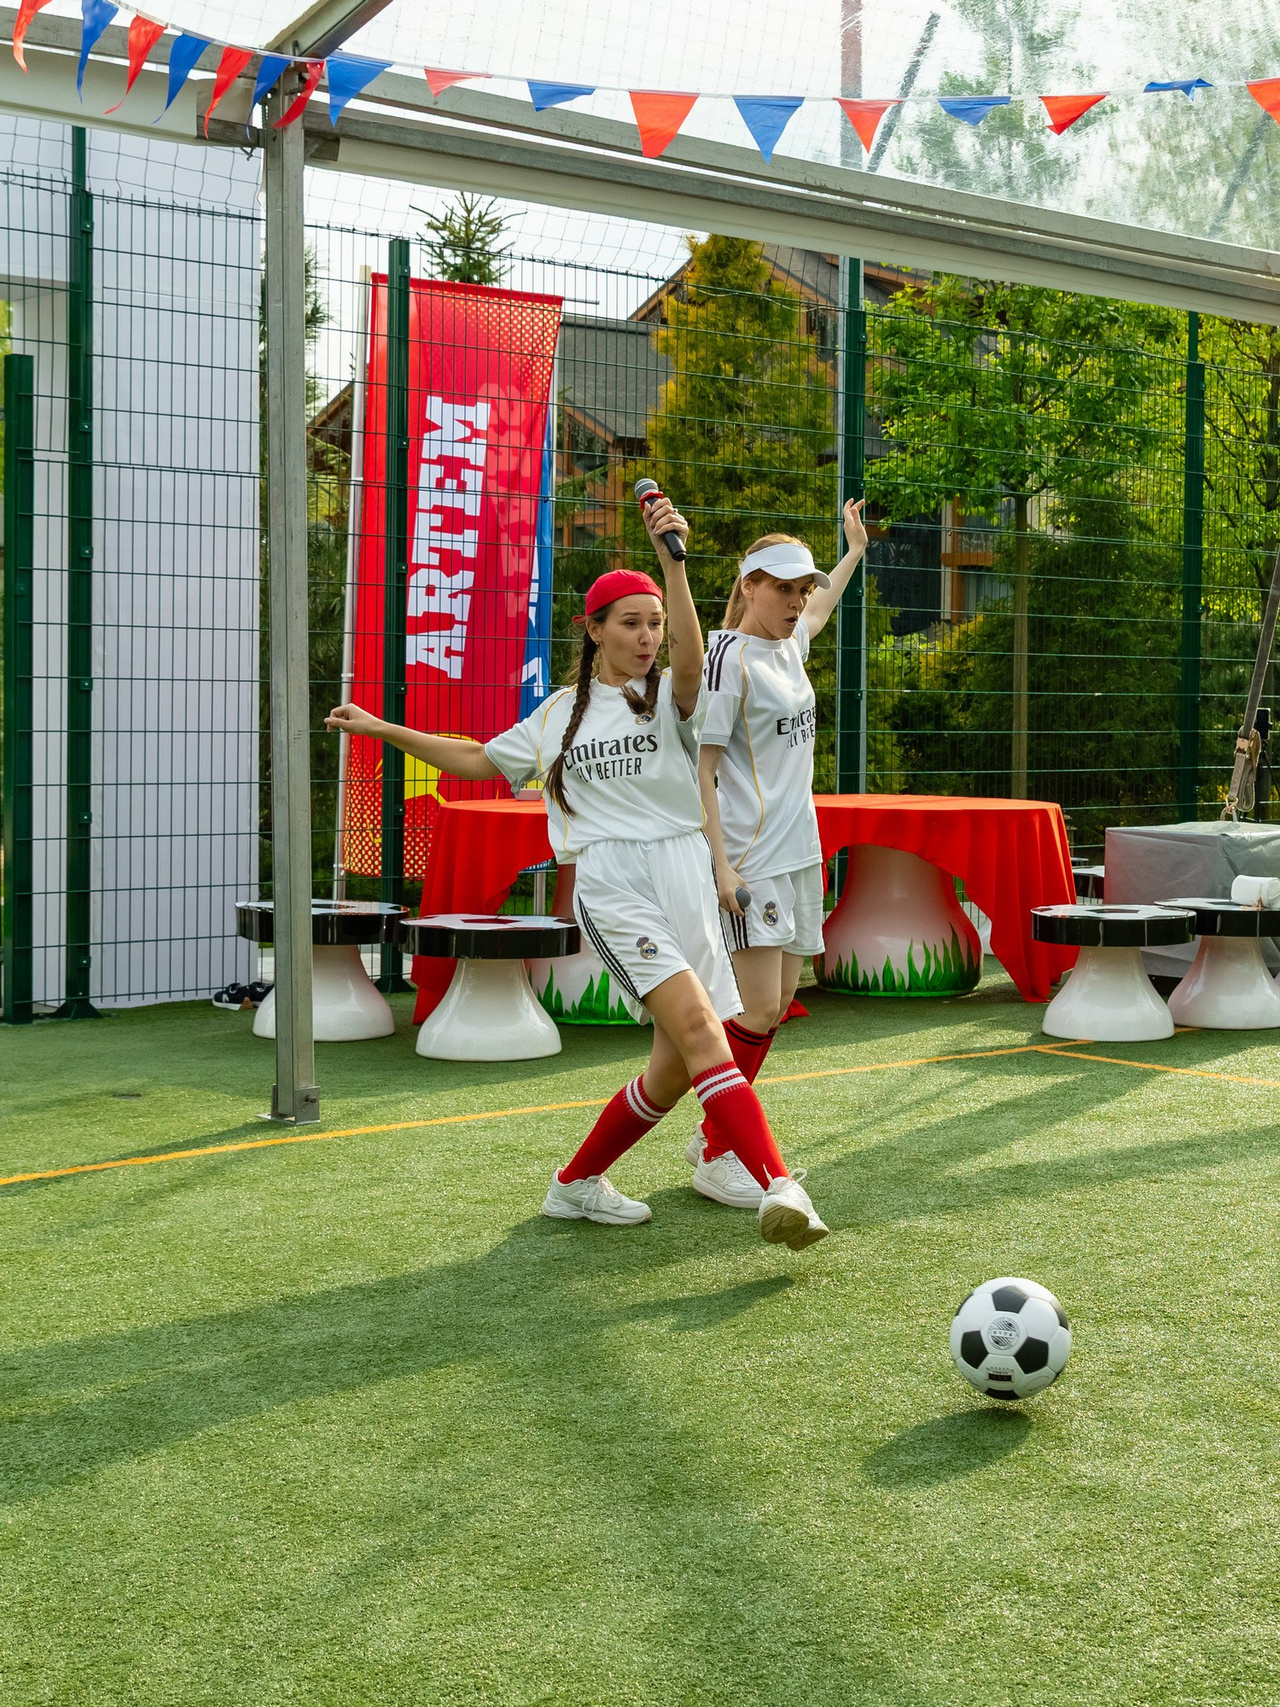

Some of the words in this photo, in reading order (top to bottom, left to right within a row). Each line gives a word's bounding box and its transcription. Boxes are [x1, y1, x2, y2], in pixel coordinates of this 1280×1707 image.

[405, 395, 491, 679] ARTEM
[563, 734, 658, 771] Emirates
[596, 757, 642, 780] BETTER
